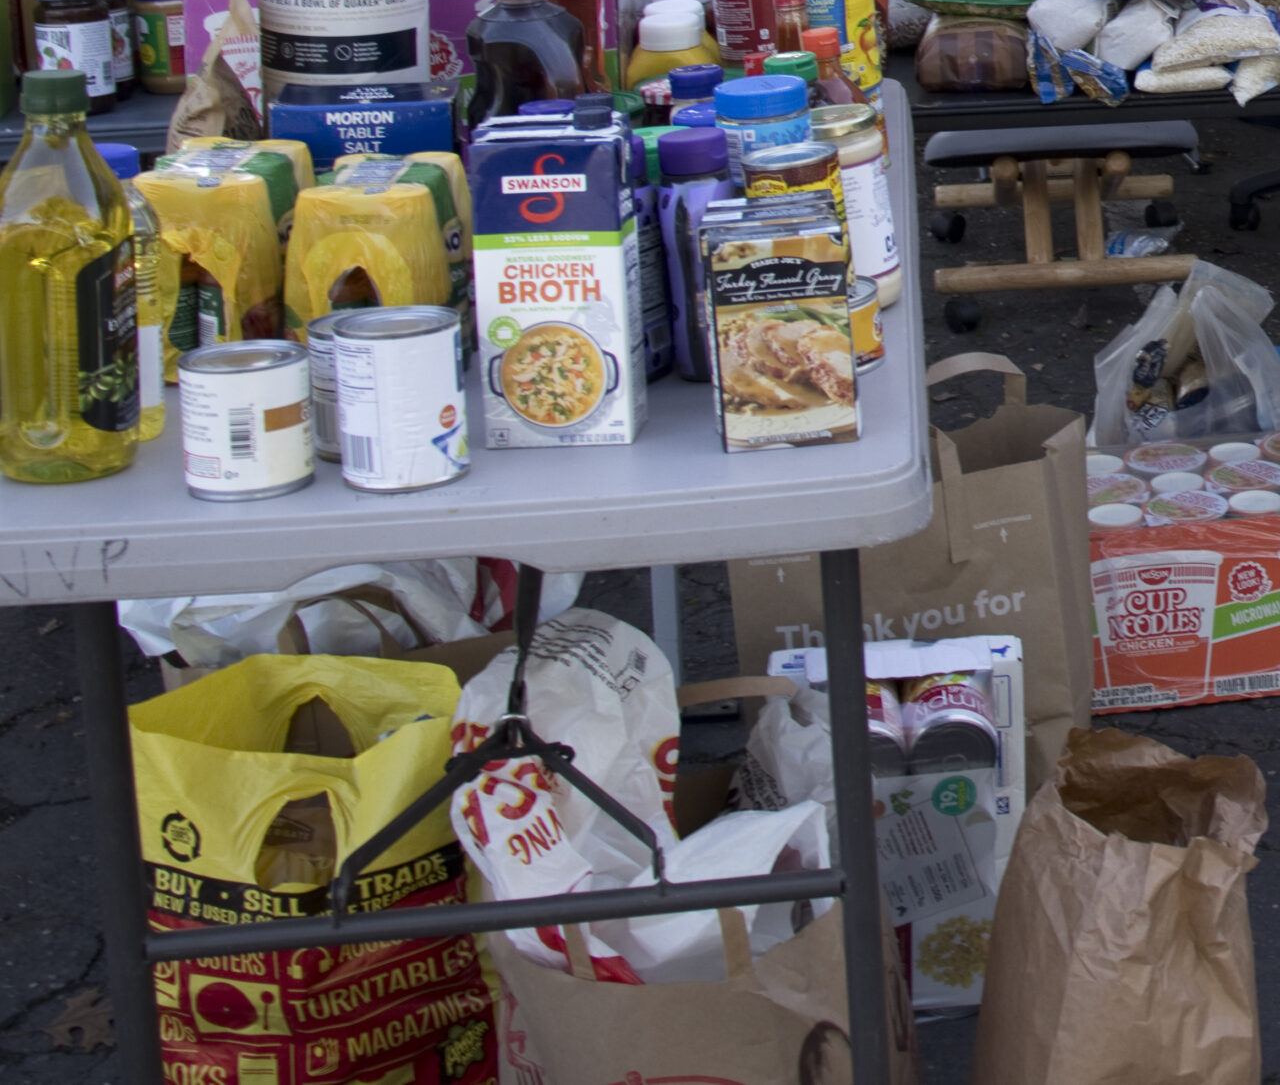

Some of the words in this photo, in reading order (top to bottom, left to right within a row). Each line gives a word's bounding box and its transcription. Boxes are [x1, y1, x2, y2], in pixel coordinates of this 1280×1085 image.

[325, 111, 395, 126] MORTON
[337, 126, 387, 140] TABLE
[344, 140, 383, 155] SALT
[506, 176, 582, 191] SWANSON
[503, 262, 596, 280] CHICKEN
[750, 257, 779, 270] TRADER
[498, 279, 601, 305] BROTH
[716, 272, 757, 298] Turkey
[759, 269, 805, 289] Flavored
[805, 267, 843, 297] Gravy
[1140, 569, 1170, 580] NISSIN
[1236, 578, 1261, 590] LOOK!
[1237, 568, 1256, 581] NEW
[1124, 587, 1188, 615] CUP
[902, 603, 966, 640] you
[973, 589, 1026, 619] for
[1107, 607, 1202, 641] NOODLES
[1119, 638, 1174, 652] CHICKEN
[1215, 675, 1246, 693] RAMEN
[1247, 673, 1280, 691] NOODLE
[354, 851, 446, 900] TRADE
[154, 867, 204, 899] BUY
[243, 888, 307, 918] SELL
[152, 891, 185, 914] NEW
[189, 900, 202, 918] &
[202, 903, 238, 926] USED
[287, 939, 474, 1022] TURNTABLES
[159, 1014, 198, 1043] CDs
[346, 987, 487, 1062] MAGAZINES
